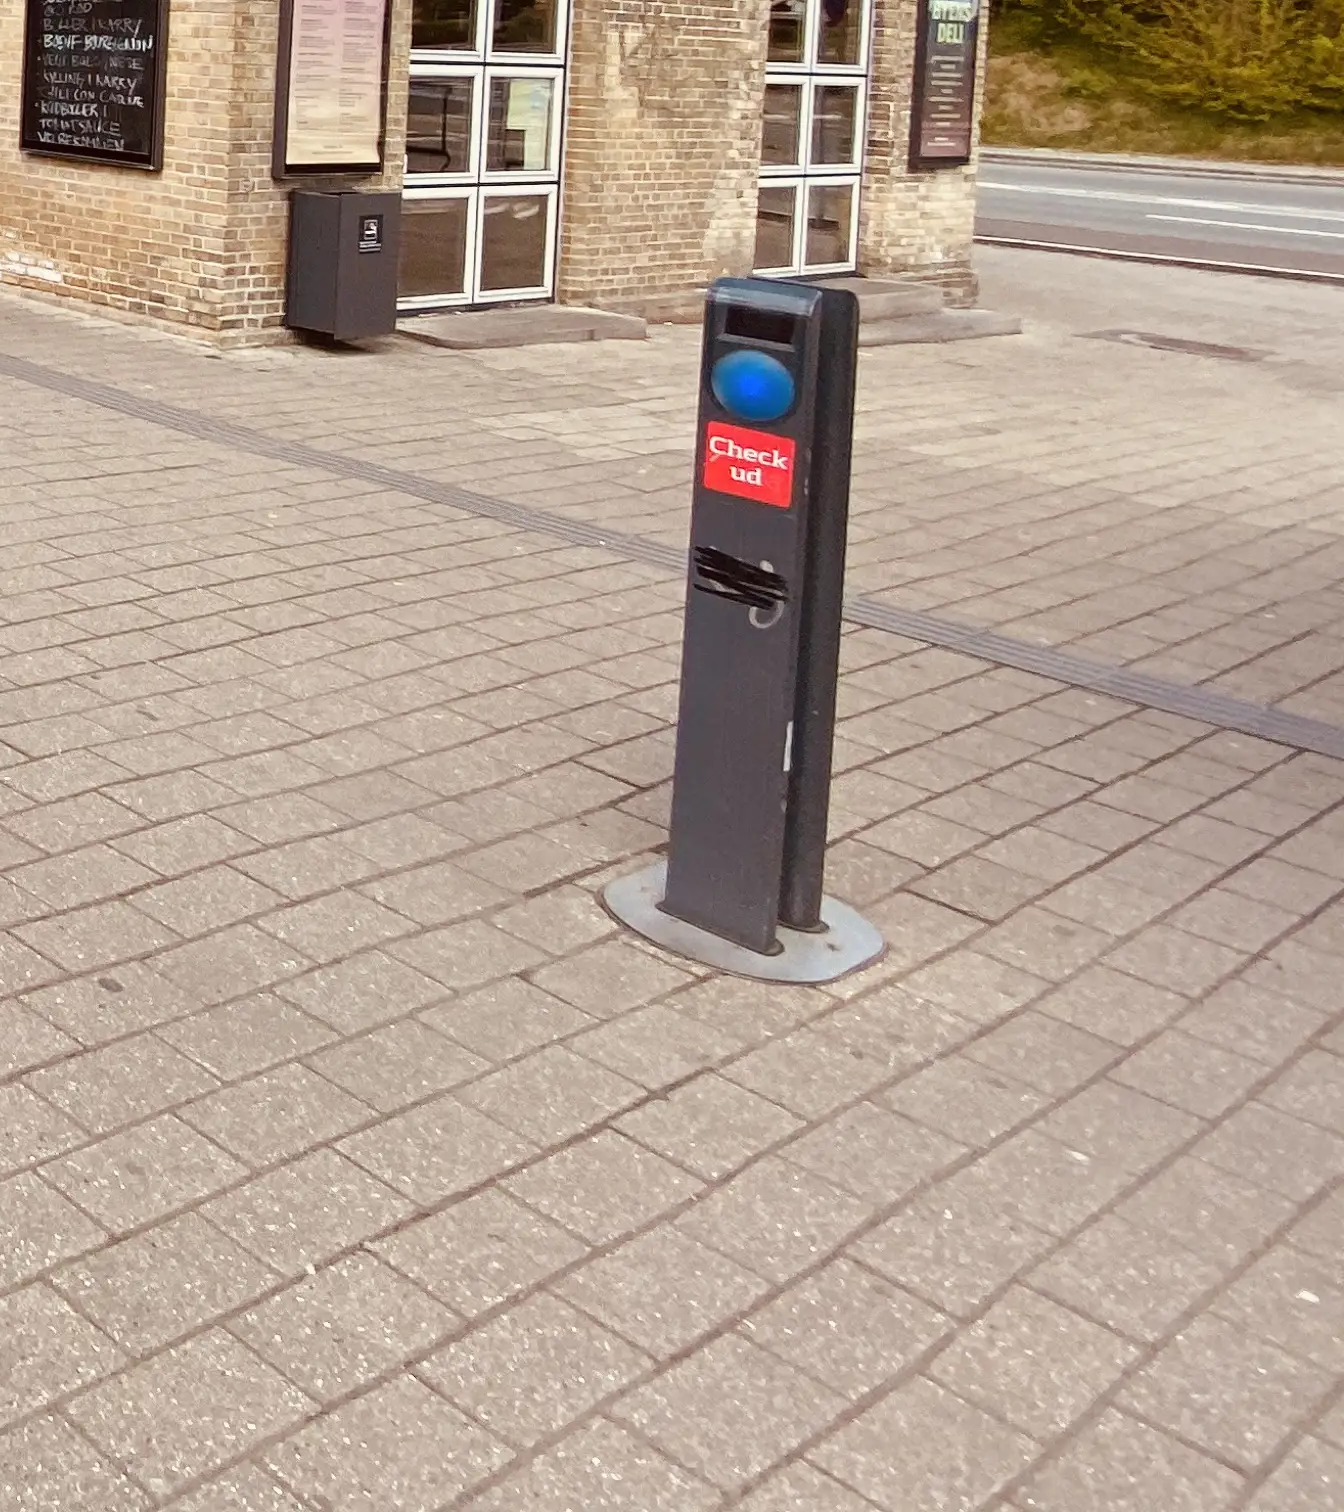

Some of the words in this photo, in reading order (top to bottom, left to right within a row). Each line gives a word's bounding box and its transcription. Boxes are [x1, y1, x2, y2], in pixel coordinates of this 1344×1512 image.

[936, 22, 965, 44] DELI
[73, 88, 95, 101] CON
[709, 436, 789, 470] Check
[729, 465, 763, 487] ud
